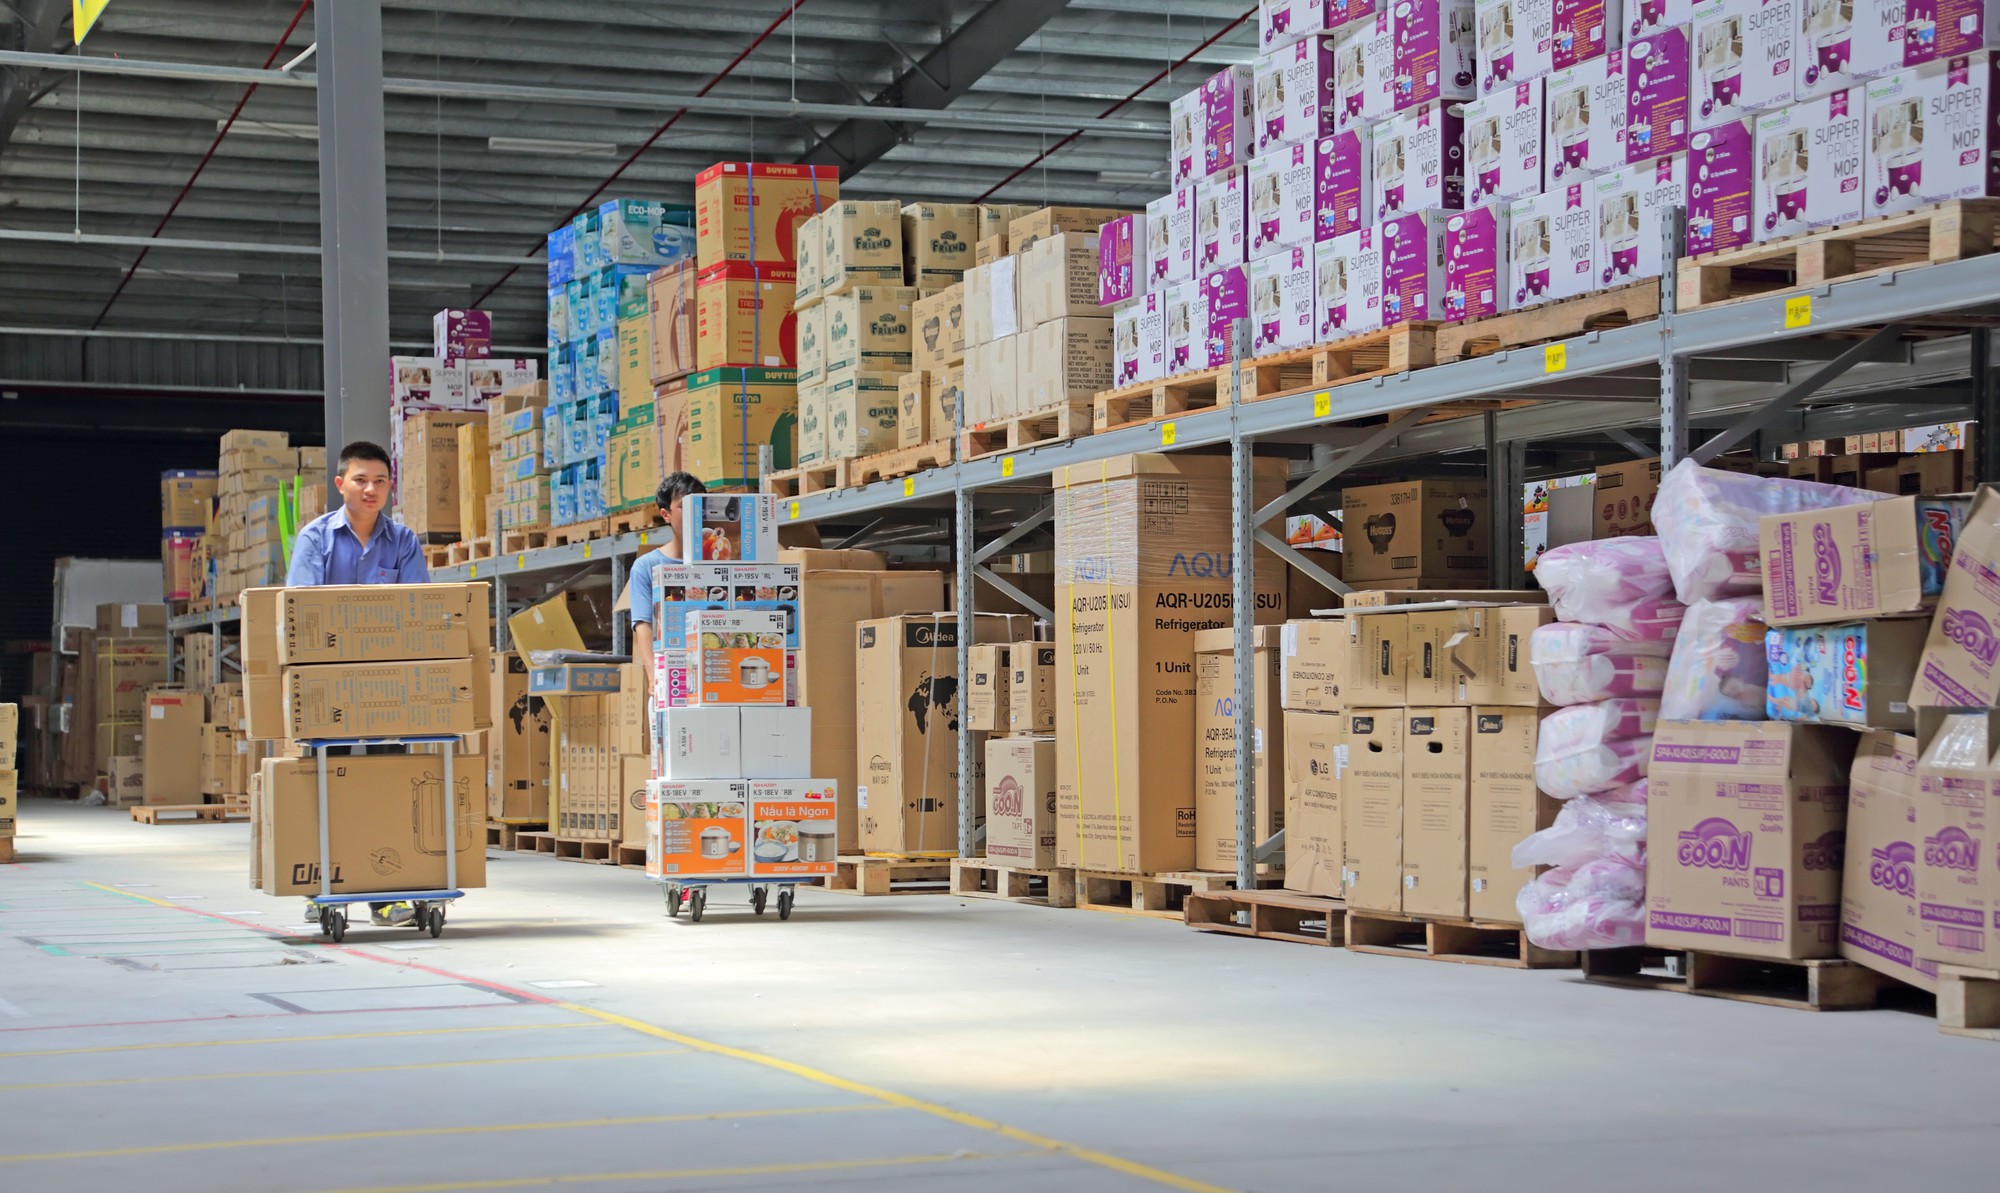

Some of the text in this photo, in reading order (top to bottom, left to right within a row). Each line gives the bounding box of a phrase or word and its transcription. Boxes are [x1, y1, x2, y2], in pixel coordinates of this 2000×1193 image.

[1695, 4, 1725, 20] Homeeasy
[1749, 2, 1791, 31] SUPPER
[1760, 21, 1790, 46] PRICE
[1610, 53, 1620, 61] TOP
[1767, 40, 1790, 62] MOP
[1287, 61, 1314, 82] SUPPER
[1954, 60, 1964, 68] TOP
[1549, 75, 1575, 90] Homeeasy
[1595, 78, 1625, 101] SUPPE
[1835, 93, 1845, 101] TOP
[1869, 83, 1903, 99] Homeeasy
[1604, 95, 1625, 114] PRIC
[1931, 87, 1982, 116] SUPPER
[1505, 107, 1537, 131] SUPPER
[1611, 113, 1625, 131] MO
[1760, 115, 1790, 131] Homeeasy
[1944, 106, 1981, 132] PRICE
[1408, 128, 1438, 150] SUPPER
[1513, 122, 1537, 142] PRICE
[1815, 119, 1859, 146] SUPPER
[1952, 128, 1980, 150] MOP
[1416, 143, 1438, 162] PRICE
[1519, 139, 1537, 158] MOP
[1827, 138, 1859, 161] PRICE
[766, 167, 798, 175] DUYTAN
[1421, 159, 1438, 176] MOP
[1834, 157, 1858, 178] MOP
[1283, 166, 1311, 186] SUPPER
[1597, 178, 1623, 192] Homeeasy
[1295, 196, 1311, 211] MOP
[1644, 184, 1681, 208] SUPPER
[628, 205, 666, 217] ECO-MOP
[1512, 203, 1537, 218] Homeeasy
[1555, 209, 1590, 232] SUPPER
[854, 237, 892, 251] FRIEND
[1564, 227, 1590, 246] PRICE
[931, 240, 967, 254] FRIEND
[1570, 243, 1590, 260] MOP
[1350, 251, 1379, 271] SUPPER
[1362, 281, 1379, 297] MOP
[1295, 299, 1310, 314] MOP
[870, 322, 907, 336] FRIEND
[435, 370, 463, 378] SUPPER
[1316, 360, 1325, 373] PT
[868, 406, 898, 418] RIEND
[1370, 526, 1392, 536] HUGGIES
[743, 531, 753, 555] Ngon
[1168, 552, 1235, 578] AQU
[1813, 523, 1838, 605] GOO.N
[1073, 593, 1131, 613] AQR-U205N(SU)
[1156, 592, 1282, 610] AQR-U205(SU)
[1073, 623, 1104, 634] Refrigerator
[1155, 618, 1225, 631] Refrigerator
[919, 629, 954, 643] Midea
[1942, 612, 2000, 668] GOO.N
[1076, 665, 1089, 675] Unit
[1155, 661, 1191, 673] 1 Unit
[1844, 635, 1863, 711] GOO.N
[1969, 660, 1991, 680] PANTS
[1292, 671, 1324, 681] CONDITIONER
[1214, 698, 1234, 717] AQ
[1205, 728, 1236, 741] AQR-95A
[1205, 748, 1236, 762] Refrigerat
[1210, 765, 1222, 775] Unit
[1318, 762, 1329, 774] LG
[1304, 788, 1337, 800] AIR CONDITIONER
[760, 804, 829, 818] Nấu là Ngon
[1178, 811, 1196, 820] RoH
[1762, 813, 1784, 822] Japan
[1760, 823, 1784, 834] Quality
[1677, 833, 1752, 871] GOO.N
[1924, 838, 1980, 872] GOO.N
[1758, 869, 1779, 877] PANTS
[1870, 860, 1915, 899] GOO.
[1957, 876, 1978, 886] PANTS
[1722, 877, 1750, 889] PANTS
[1756, 879, 1765, 892] XL
